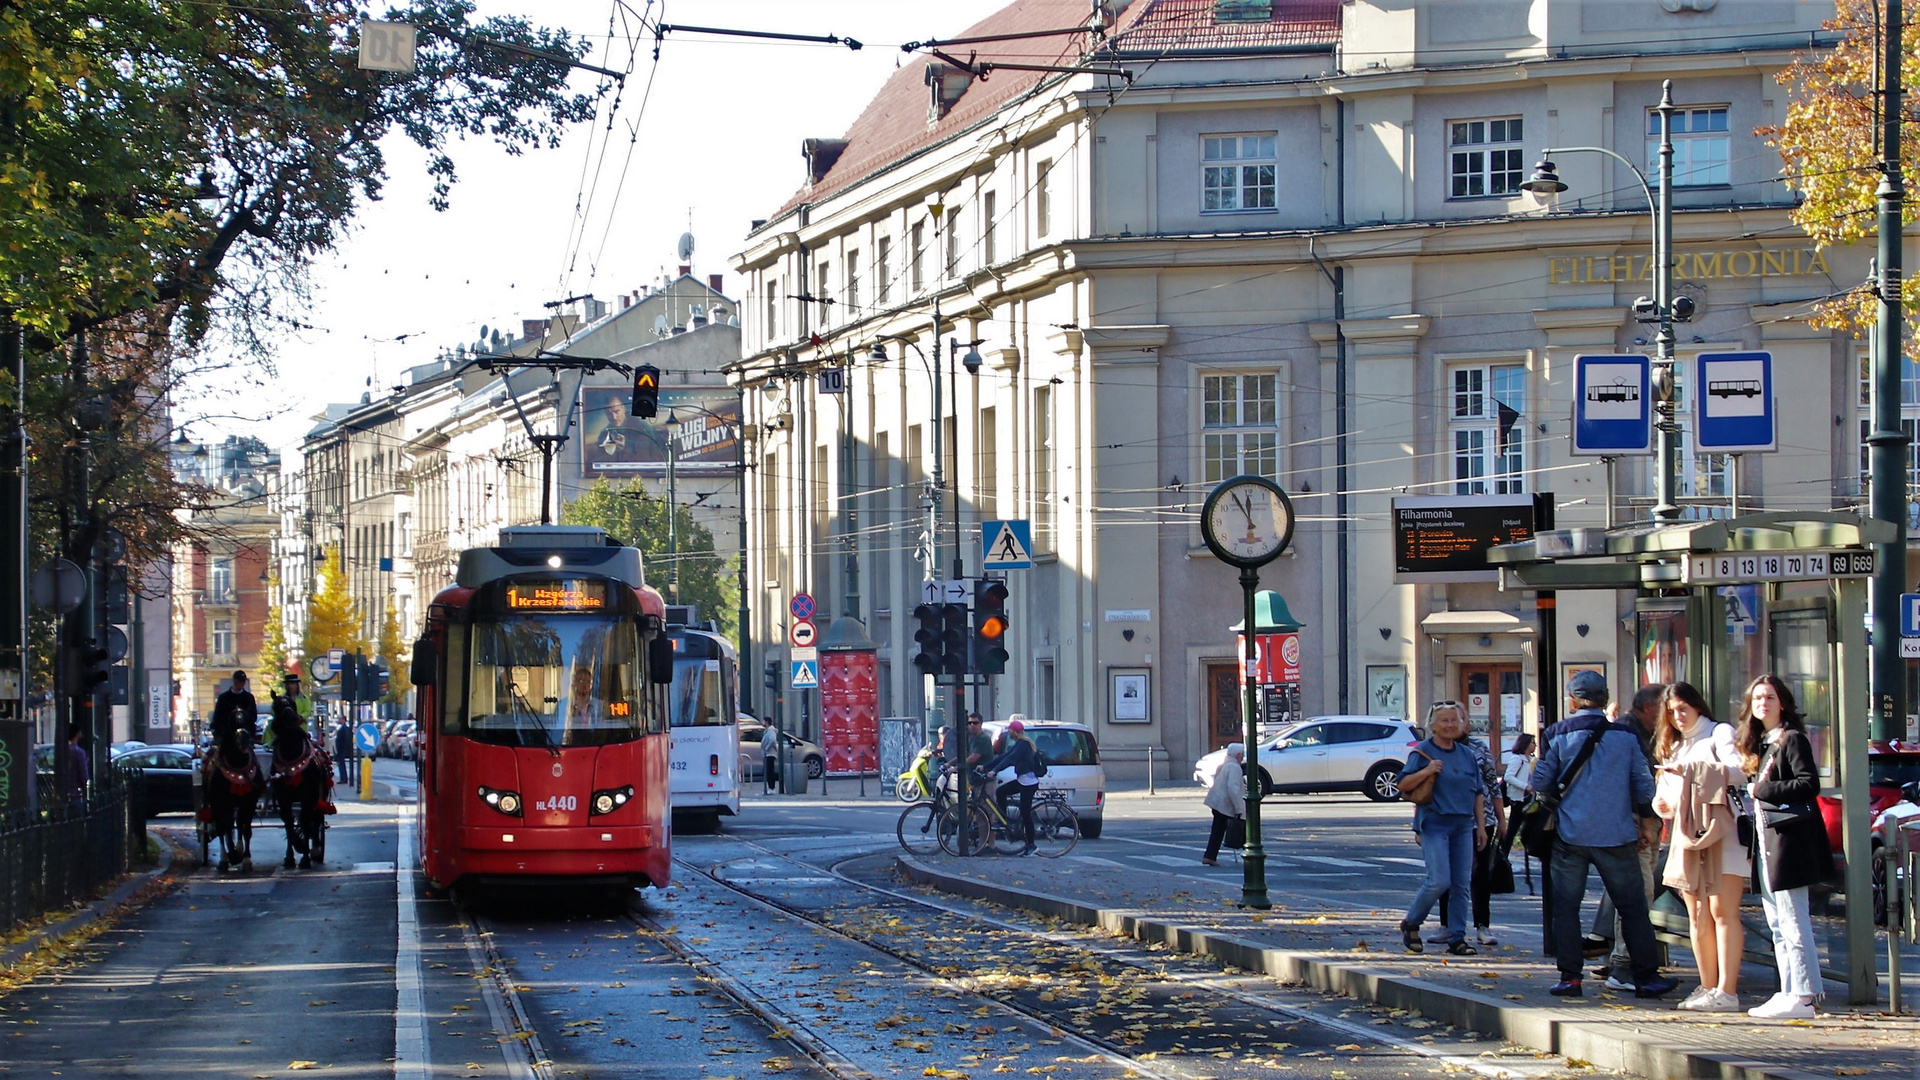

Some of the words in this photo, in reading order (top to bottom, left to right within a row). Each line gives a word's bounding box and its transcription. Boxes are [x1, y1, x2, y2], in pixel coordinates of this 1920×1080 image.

[1549, 249, 1832, 285] FILHARMONIA
[821, 371, 841, 389] 10
[681, 425, 728, 451] WOJNY
[1244, 488, 1253, 497] 12
[1220, 504, 1229, 512] 10
[1400, 508, 1453, 519] Filharmonia
[1221, 533, 1228, 541] 8
[1233, 543, 1239, 551] 7
[1247, 546, 1253, 554] 6
[1699, 563, 1704, 575] 1
[1721, 562, 1728, 574] 8
[1741, 561, 1754, 574] 13
[1765, 560, 1777, 573] 18
[1788, 559, 1801, 572] 70
[1810, 558, 1823, 572] 74
[1833, 557, 1846, 571] 69
[1853, 556, 1873, 571] 669
[507, 589, 518, 607] 1
[534, 589, 584, 598] Wzgórza
[518, 597, 601, 606] Krzesławickie
[1904, 643, 1920, 652] Ko
[152, 695, 161, 725] Gossip
